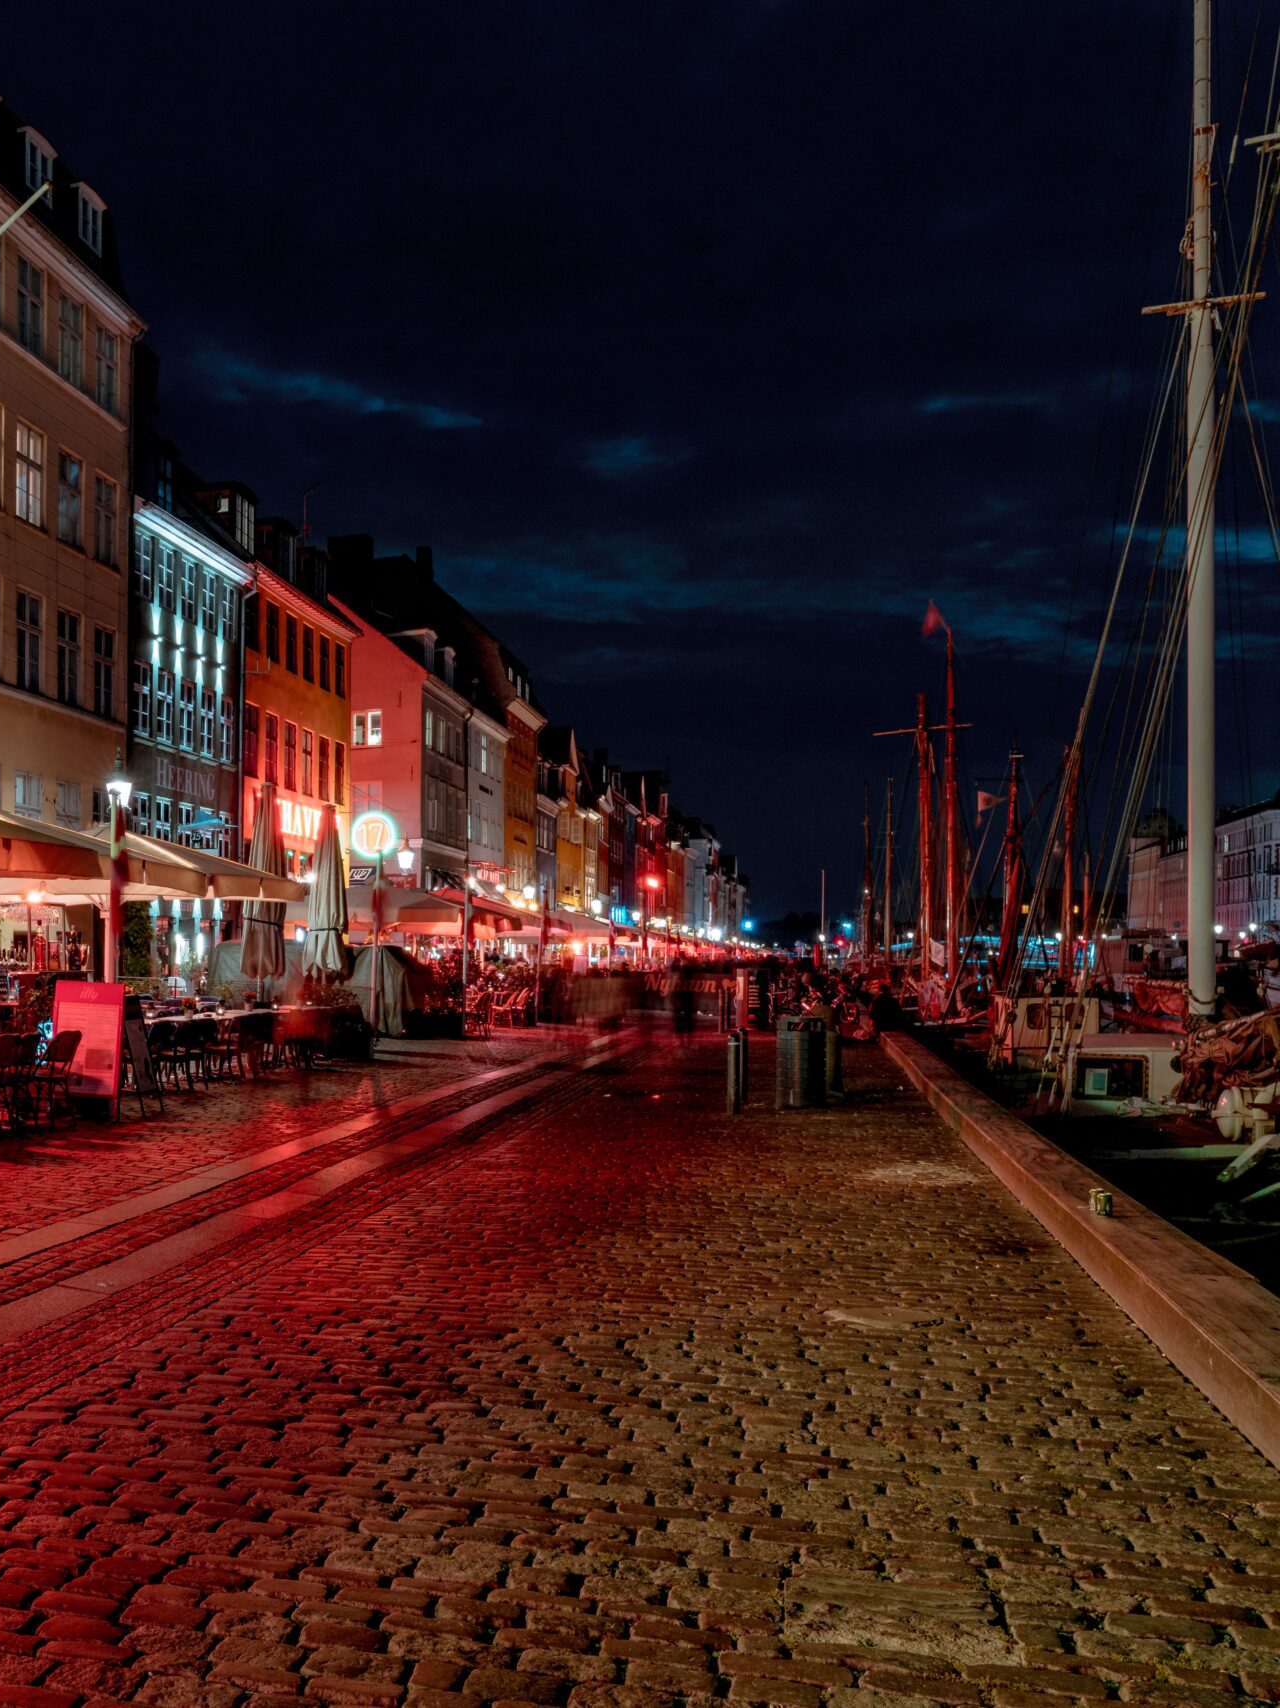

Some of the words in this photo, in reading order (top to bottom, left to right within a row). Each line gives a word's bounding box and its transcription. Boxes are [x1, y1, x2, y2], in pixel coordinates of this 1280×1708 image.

[155, 757, 216, 801] HEERING
[357, 822, 385, 851] 17
[79, 986, 99, 999] illy
[644, 973, 717, 997] Nyhavn
